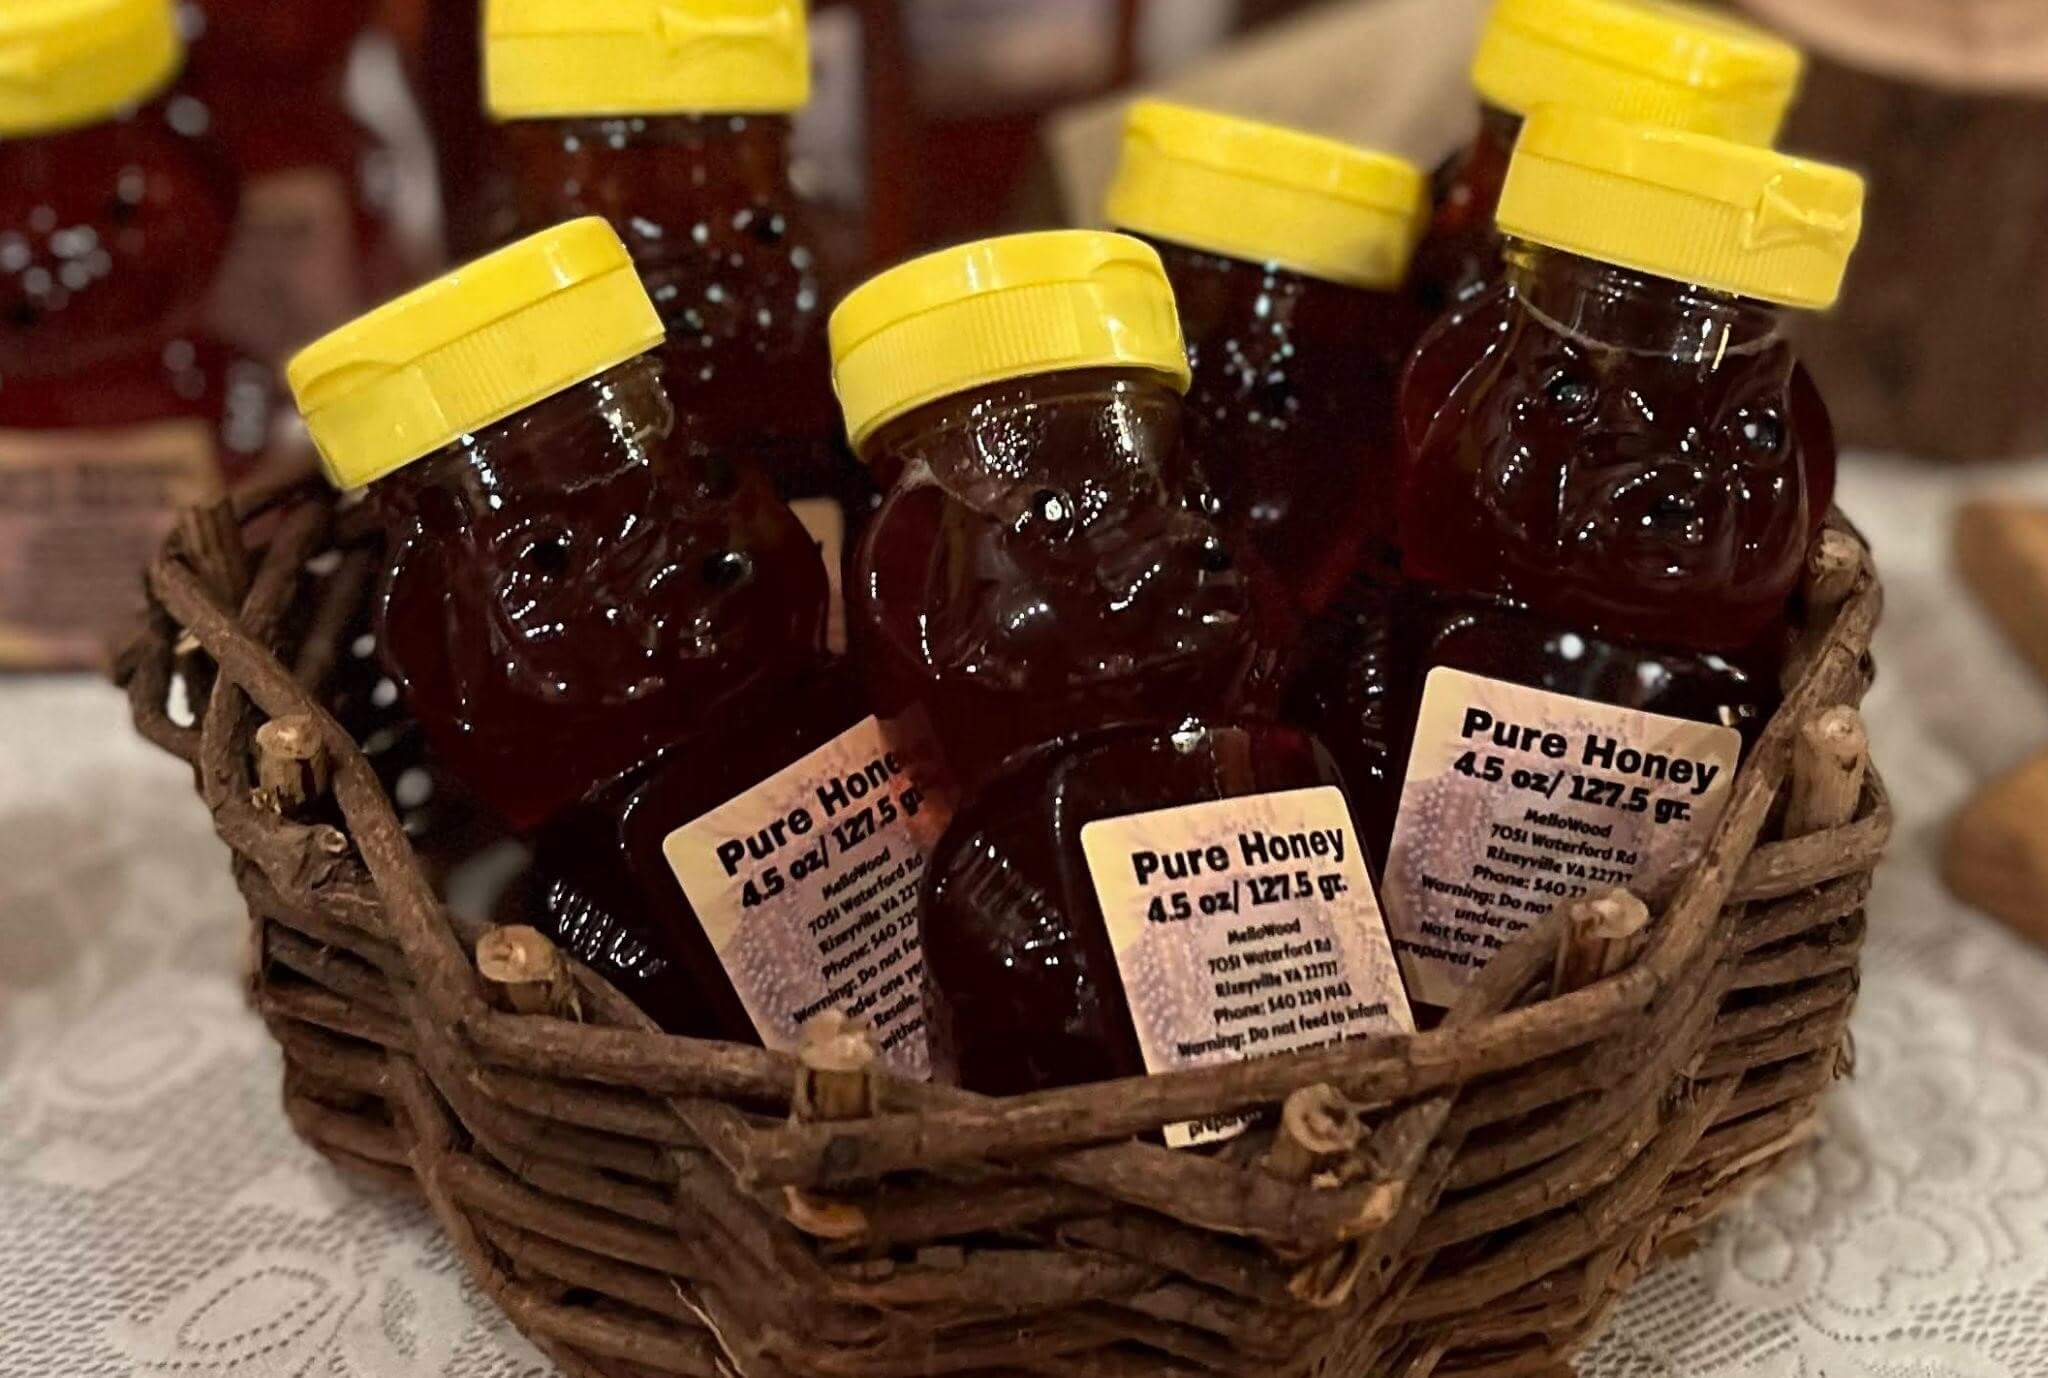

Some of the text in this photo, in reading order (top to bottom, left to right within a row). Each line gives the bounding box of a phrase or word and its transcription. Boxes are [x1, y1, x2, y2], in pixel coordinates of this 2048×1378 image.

[1461, 708, 1719, 795] Pure Honey
[1454, 751, 1691, 824] 4.5 oz/ 127.5 gr.
[715, 751, 903, 877] Pure Hone
[1524, 807, 1613, 838] MelloWood
[1131, 828, 1344, 886] Pure Honey
[1490, 823, 1637, 865] 7051 Waterford Rd
[743, 866, 785, 909] 4.5
[790, 835, 829, 880] oz/
[1473, 864, 1531, 889] Phone:
[1533, 877, 1567, 896] 540
[1567, 862, 1586, 878] VA
[1147, 870, 1348, 924] 4.5 oz/ 127.5 gr.
[1421, 874, 1496, 905] Warning:
[1498, 893, 1522, 909] Do
[1420, 921, 1450, 939] Not
[1454, 927, 1480, 944] for
[1454, 908, 1505, 928] under
[857, 965, 878, 985] Do
[879, 947, 902, 971] not
[1242, 939, 1313, 966] Waterford
[1314, 937, 1332, 953] Rd
[1283, 966, 1303, 983] VA
[846, 990, 878, 1018] nder
[879, 974, 904, 997] one
[1213, 1002, 1266, 1025] Phone:
[1177, 1031, 1247, 1057] Warning:
[1248, 1026, 1269, 1043] Do
[1271, 1019, 1296, 1038] not
[1299, 1012, 1329, 1031] feed
[1330, 1010, 1345, 1025] to
